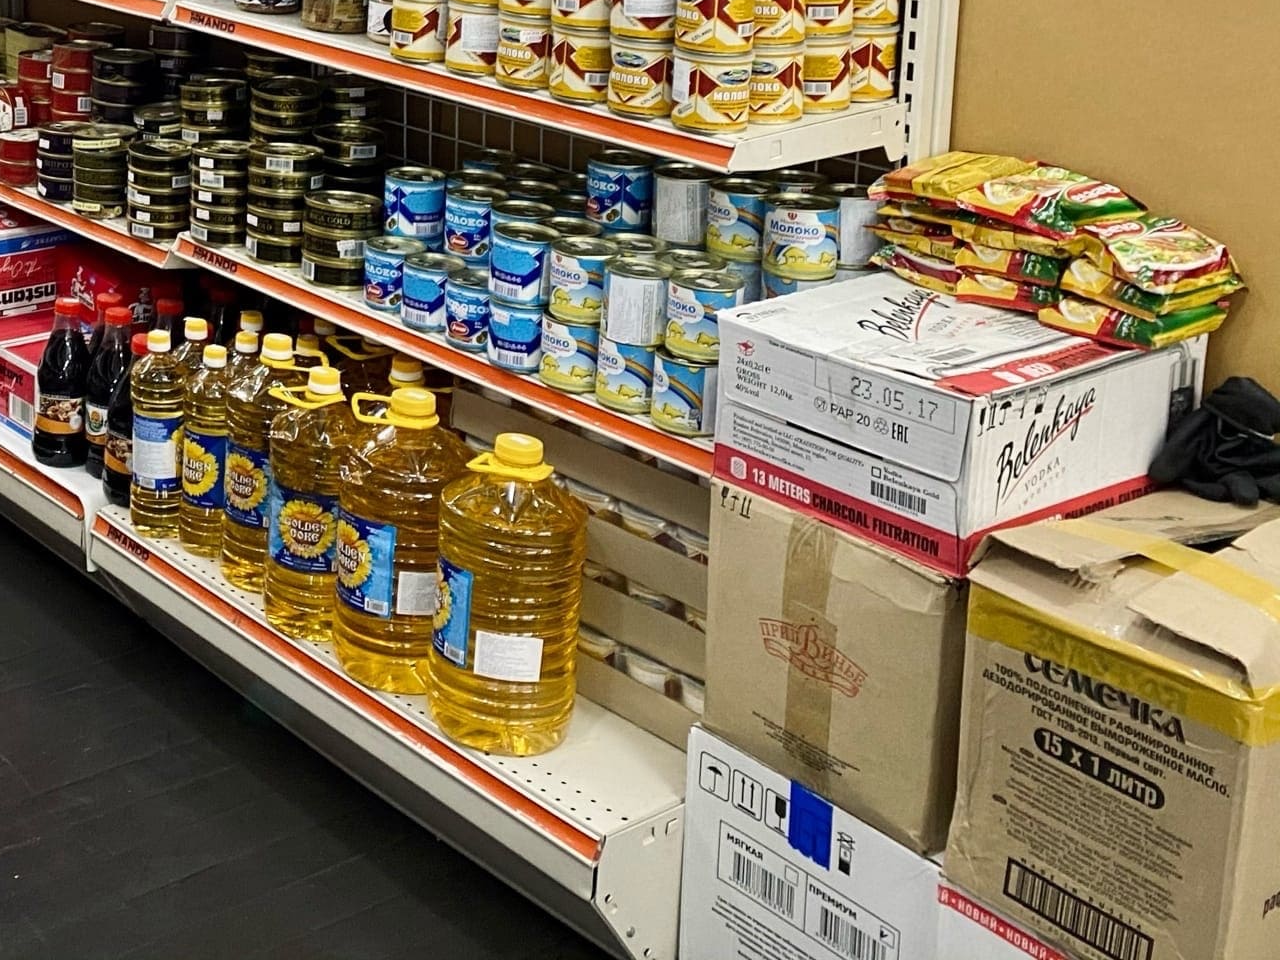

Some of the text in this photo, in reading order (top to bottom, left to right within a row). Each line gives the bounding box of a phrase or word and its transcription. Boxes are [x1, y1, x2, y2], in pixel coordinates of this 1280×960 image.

[770, 220, 819, 236] Молоко
[830, 404, 870, 427] PAP 20
[996, 388, 1096, 515] Belenkaya
[1024, 457, 1060, 492] VODKA
[752, 468, 940, 556] 13 METERS CHARCOAL FILTRATION
[982, 669, 1088, 728] ДЕЗОДОРИРОВАННОЕ
[1090, 721, 1184, 774] ВЫМОРОЖЕННОЕ
[995, 663, 1216, 776] 100% ПОДСОЛНЕЧНОЕ РАФИНИРОВАННОЕ
[1042, 731, 1062, 756] 15
[1092, 757, 1100, 777] 1
[1107, 771, 1158, 808] ЛИТР
[726, 832, 764, 861] МЯГКАЯ
[809, 883, 858, 920] ПРЕМИУМ
[956, 895, 998, 932] НОВЫЙ
[1006, 928, 1049, 960] НОВЫЙ
